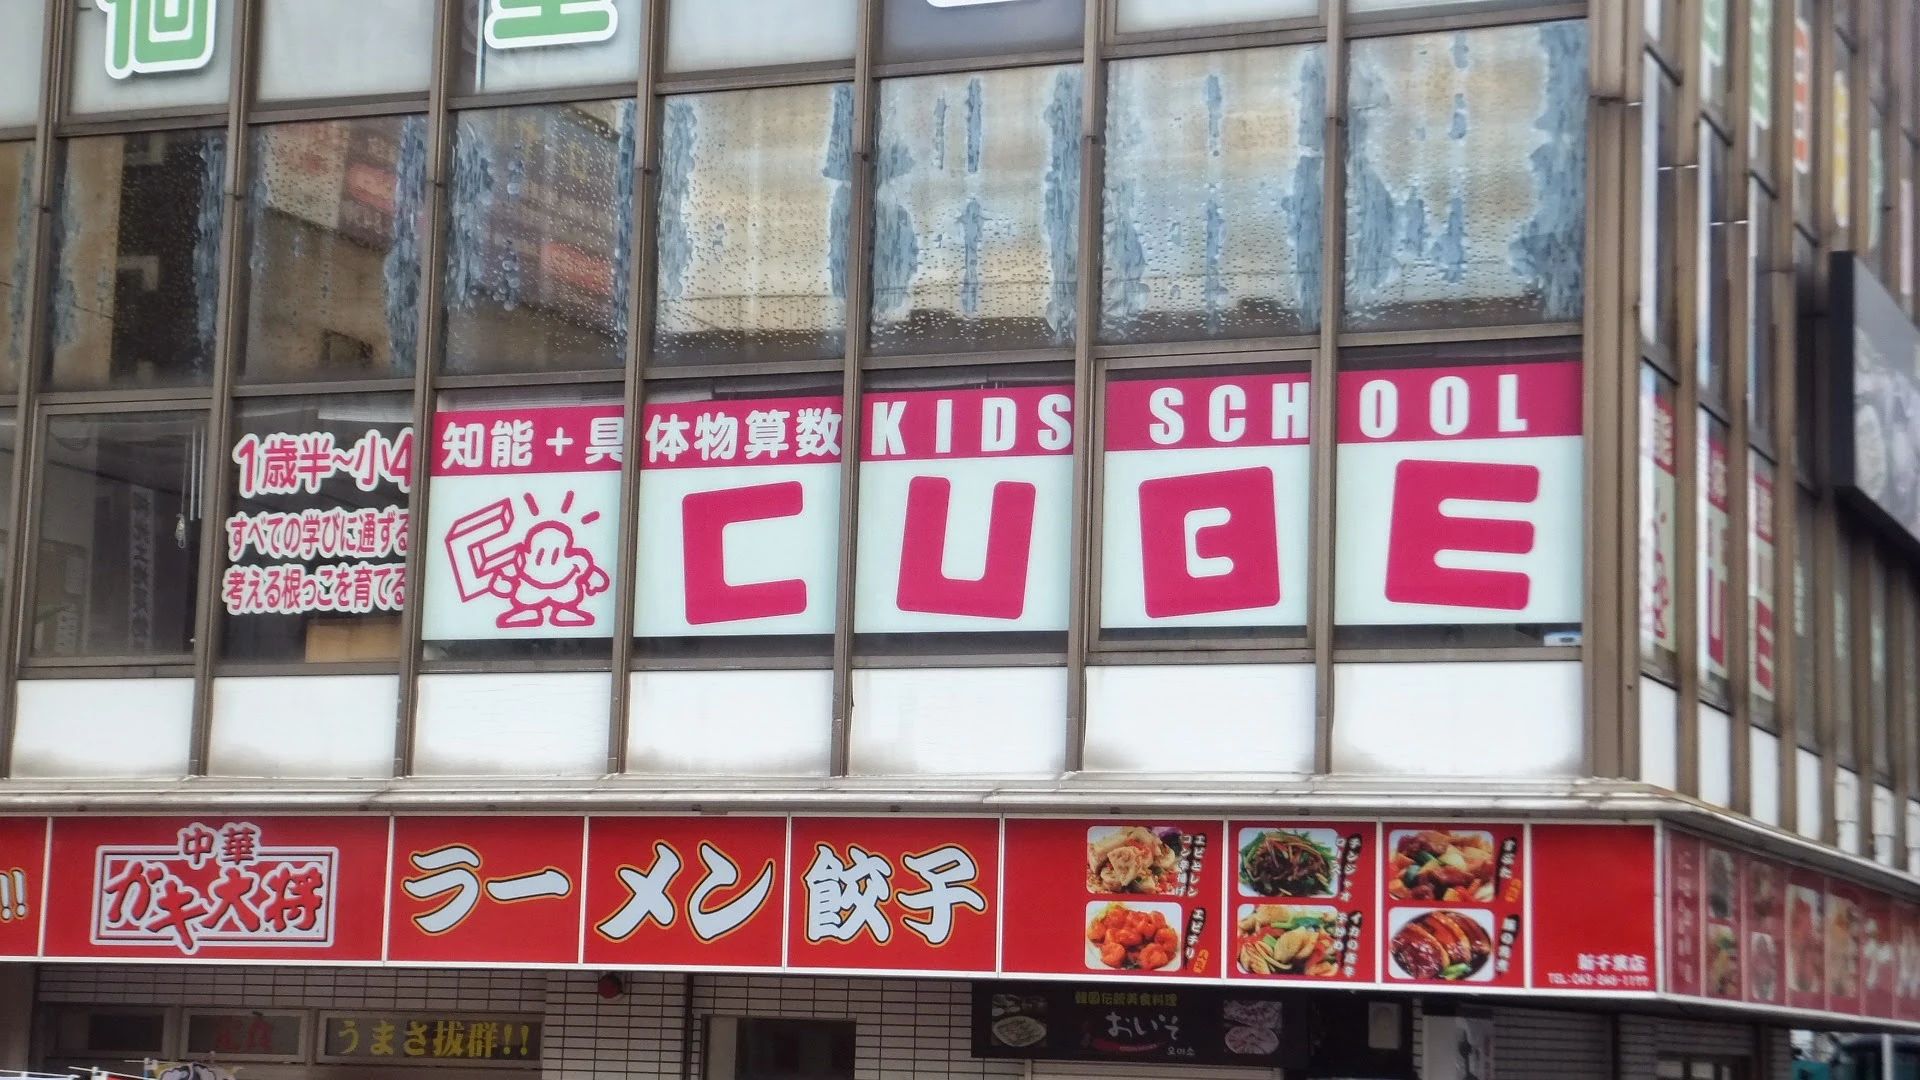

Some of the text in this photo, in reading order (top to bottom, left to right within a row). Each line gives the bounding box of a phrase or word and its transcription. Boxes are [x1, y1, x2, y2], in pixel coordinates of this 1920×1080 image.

[871, 373, 1529, 456] KIDS SCHOOL
[682, 458, 1540, 626] CUBE
[182, 827, 256, 864] 中華
[104, 861, 324, 949] ガキ大将
[402, 840, 986, 944] ラーメン 餃子
[1185, 908, 1205, 960] エビチリ
[337, 1020, 531, 1057] うまさ抜群!!
